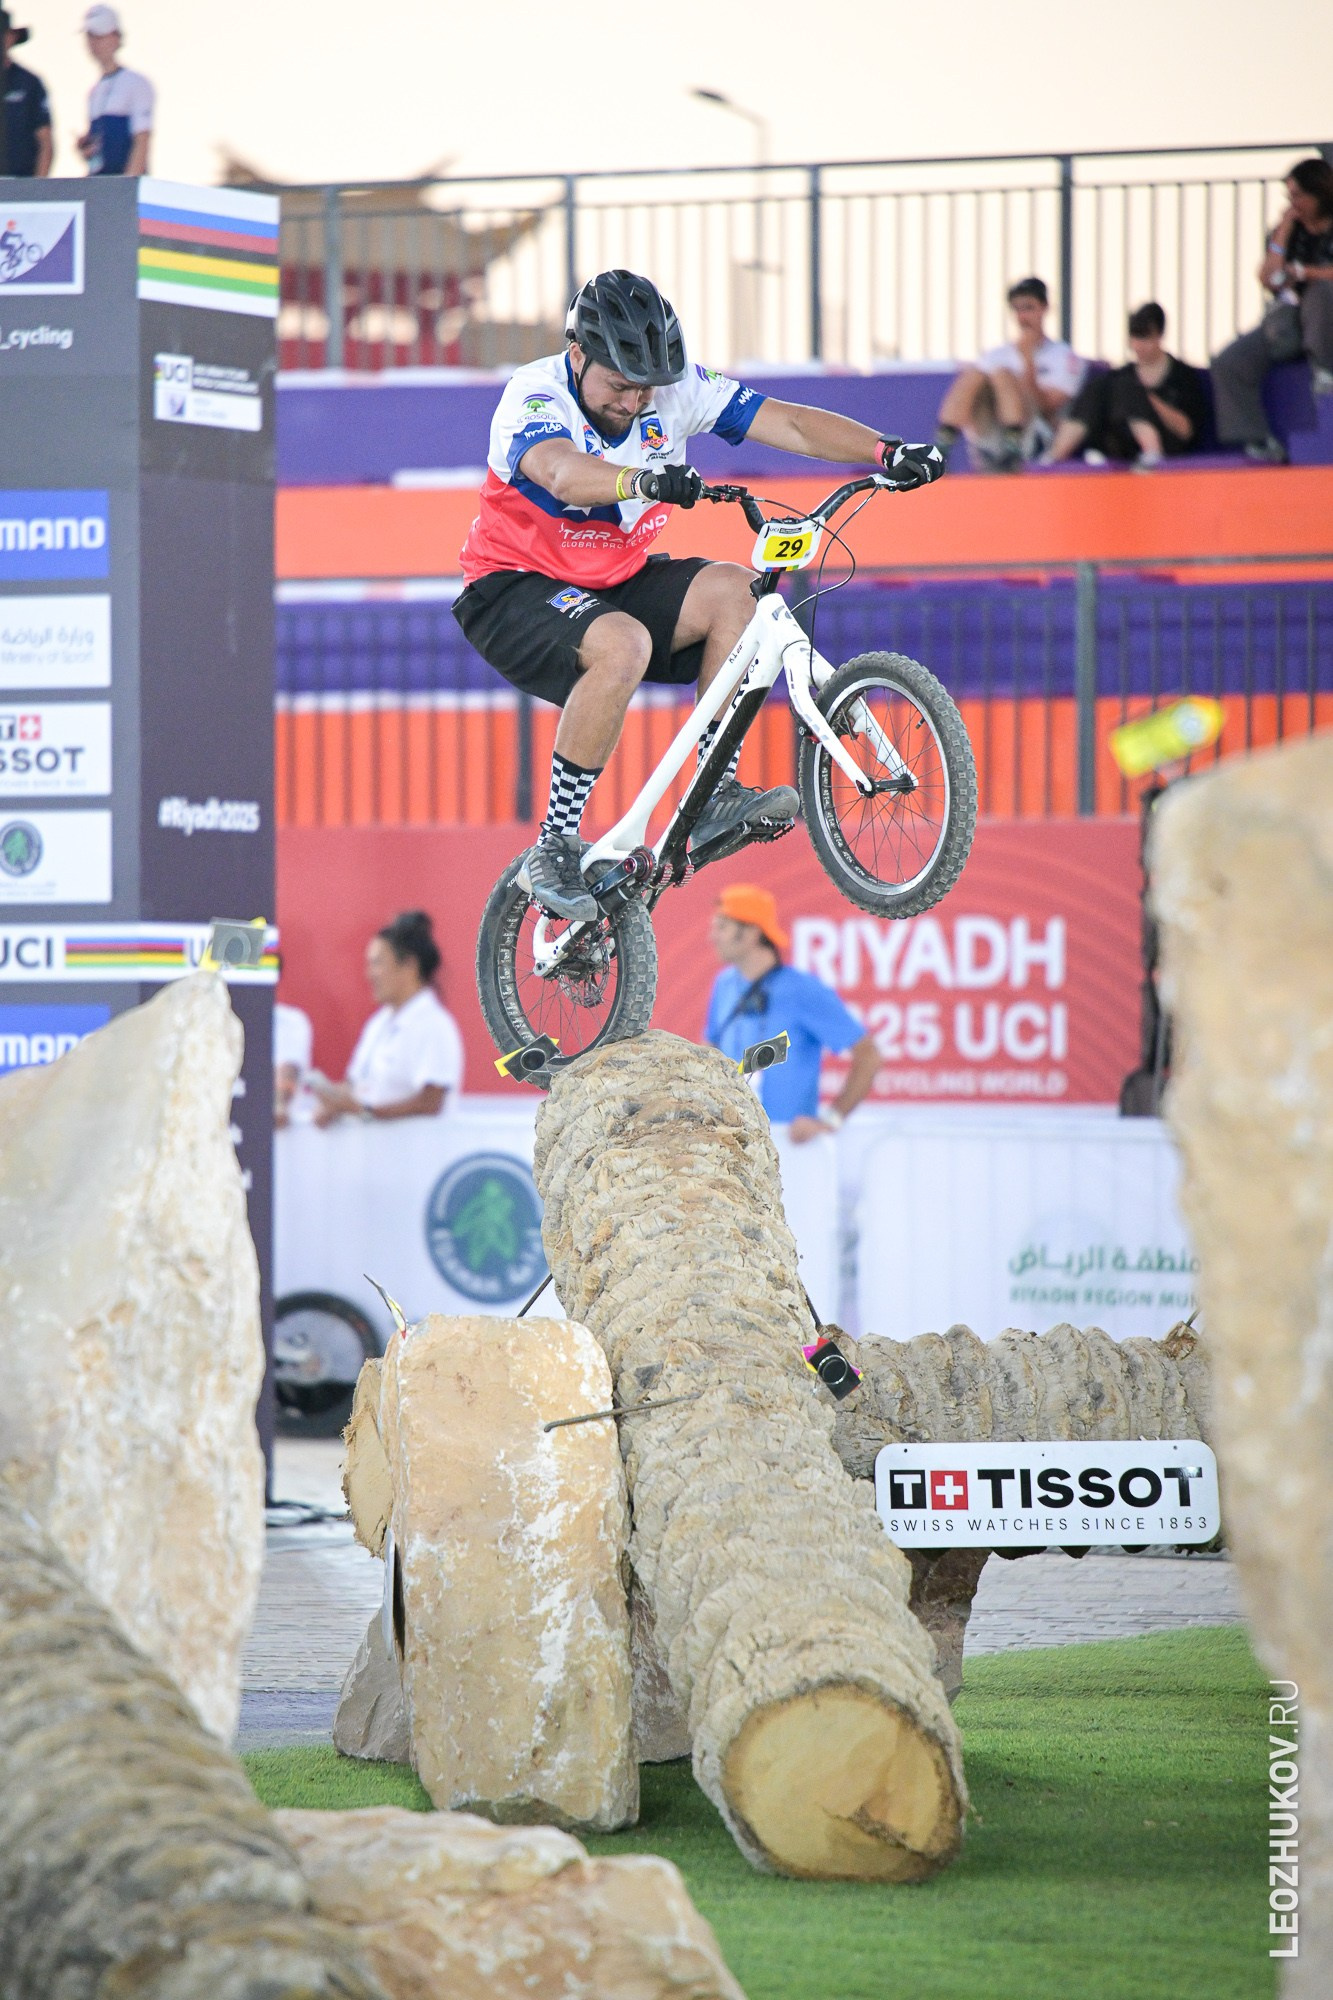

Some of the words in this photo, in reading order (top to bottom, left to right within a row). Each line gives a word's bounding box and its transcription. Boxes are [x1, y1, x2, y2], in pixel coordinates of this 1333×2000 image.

[0, 325, 73, 350] _cycling
[561, 540, 598, 549] GLOBAL
[775, 538, 803, 558] 29
[794, 916, 1067, 991] RIYADH
[846, 1002, 943, 1061] 25
[955, 1003, 1068, 1061] UCI
[977, 1466, 1204, 1510] TISSOT
[890, 1518, 956, 1533] SWISS
[967, 1517, 1069, 1532] WATCHES
[1081, 1517, 1147, 1531] SINCE
[1158, 1516, 1209, 1530] 1853
